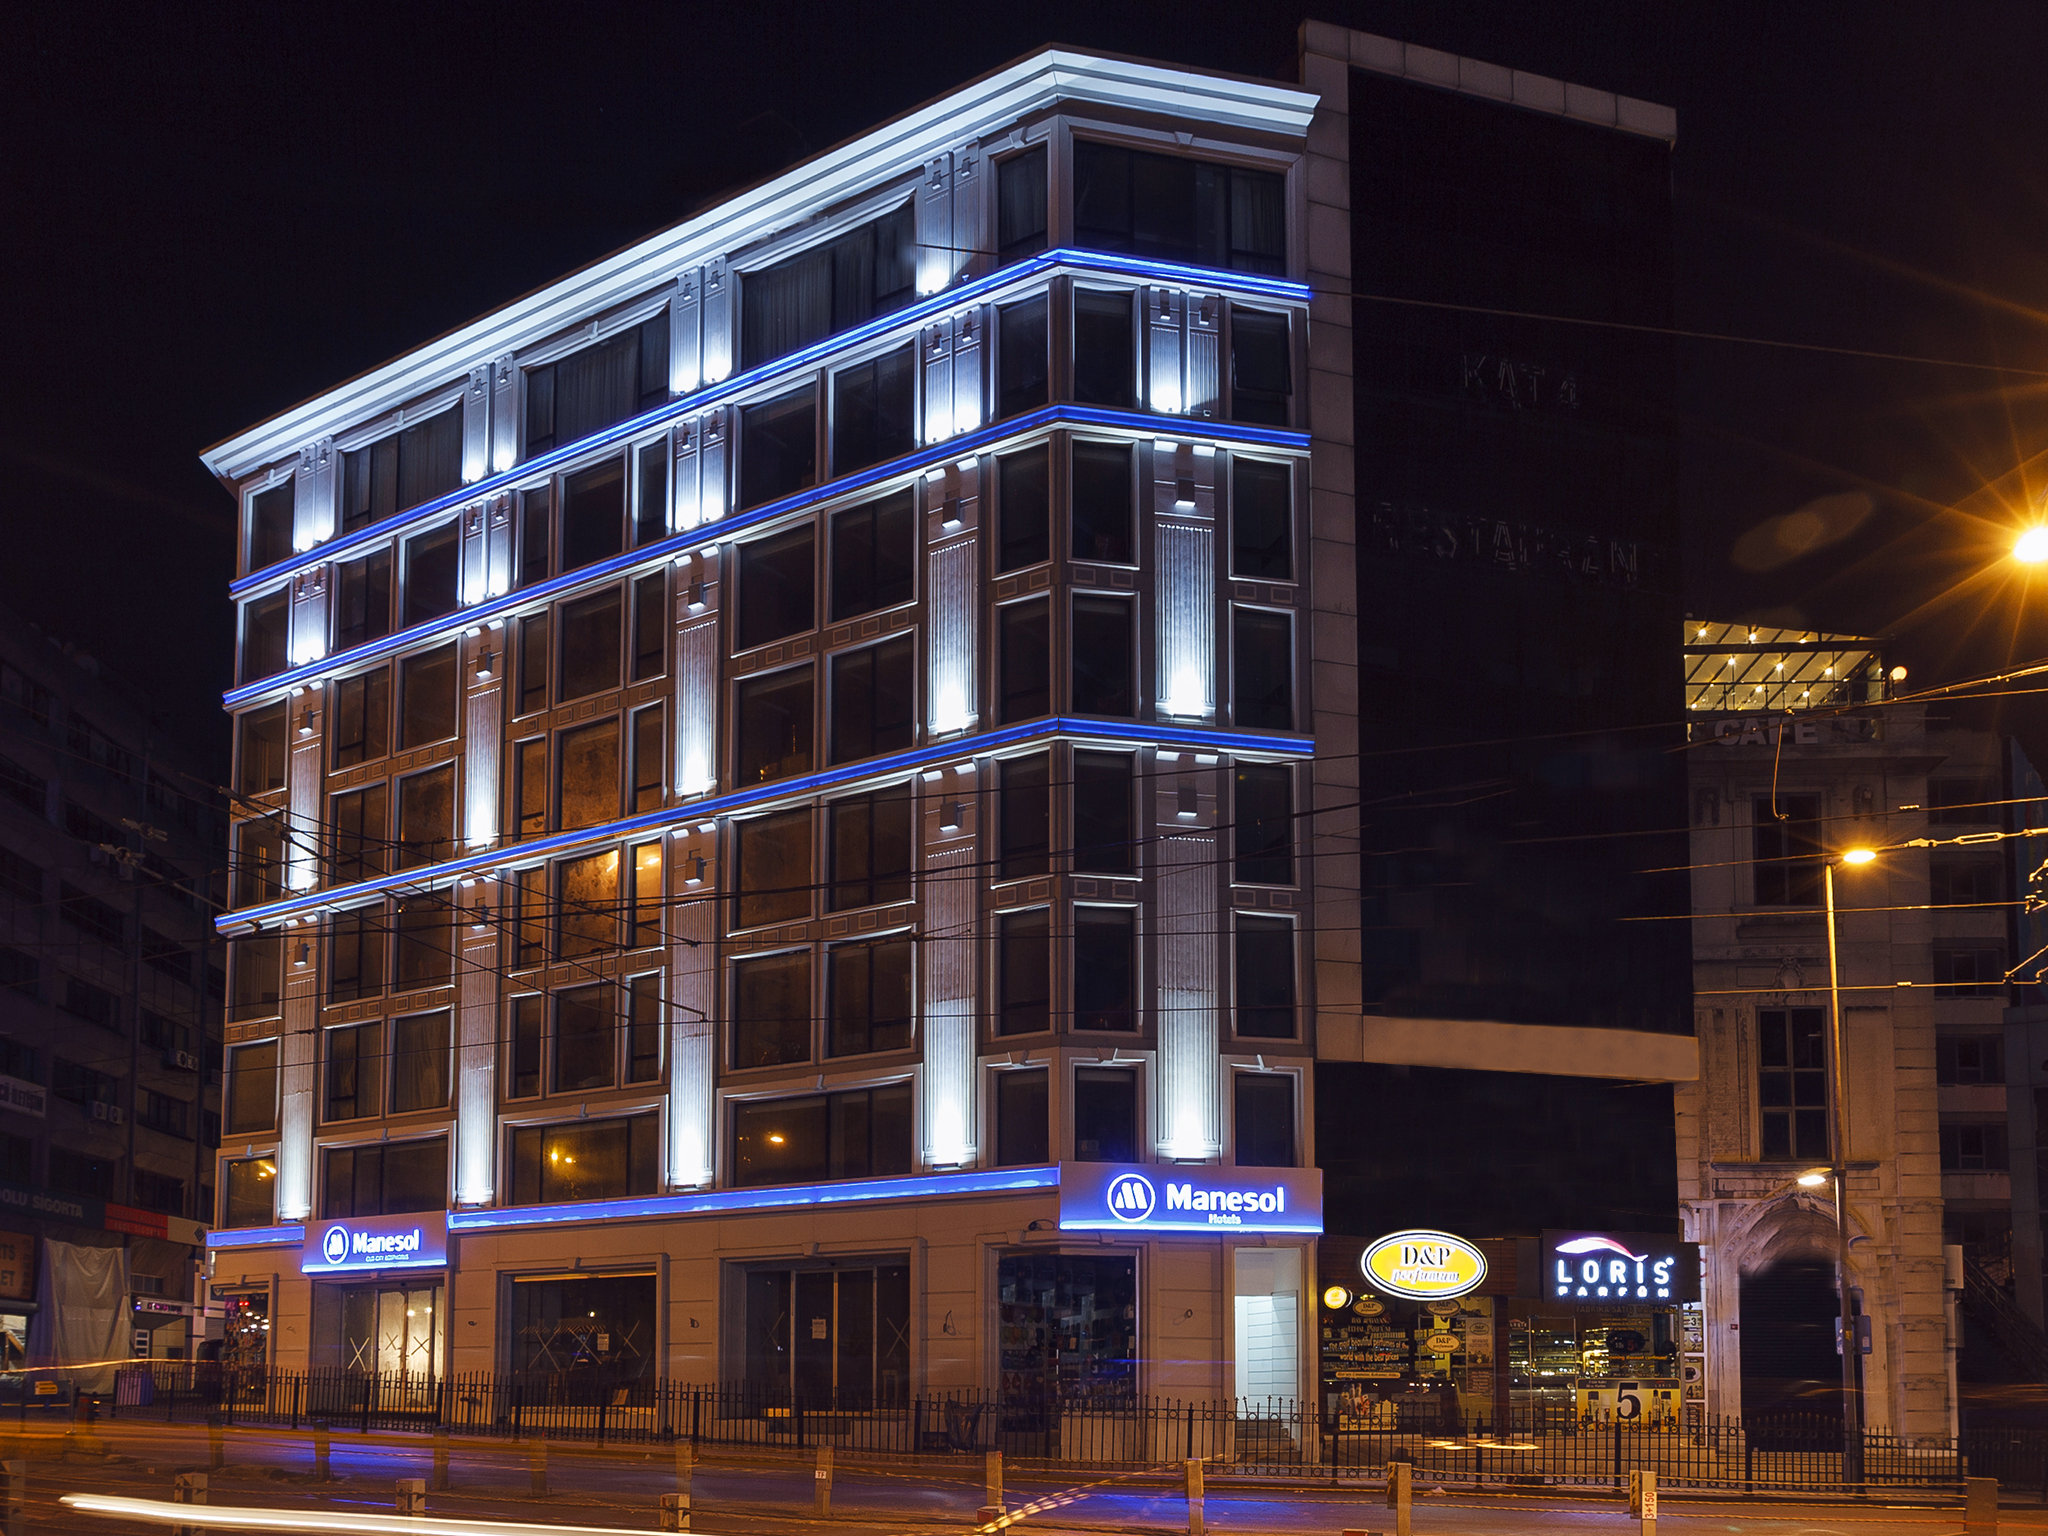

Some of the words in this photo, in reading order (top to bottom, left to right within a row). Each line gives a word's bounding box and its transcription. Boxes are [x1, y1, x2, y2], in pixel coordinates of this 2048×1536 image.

[1714, 716, 1819, 746] CAFE
[0, 1187, 28, 1207] OLU
[1166, 1182, 1285, 1213] Manesol
[0, 1243, 16, 1261] TS
[353, 1229, 420, 1254] Manesol
[1401, 1244, 1451, 1267] D&P
[0, 1269, 15, 1287] ET
[1690, 1317, 1697, 1326] 3
[1617, 1382, 1641, 1420] 5
[1686, 1386, 1694, 1398] 4
[1644, 1491, 1655, 1519] 3+150
